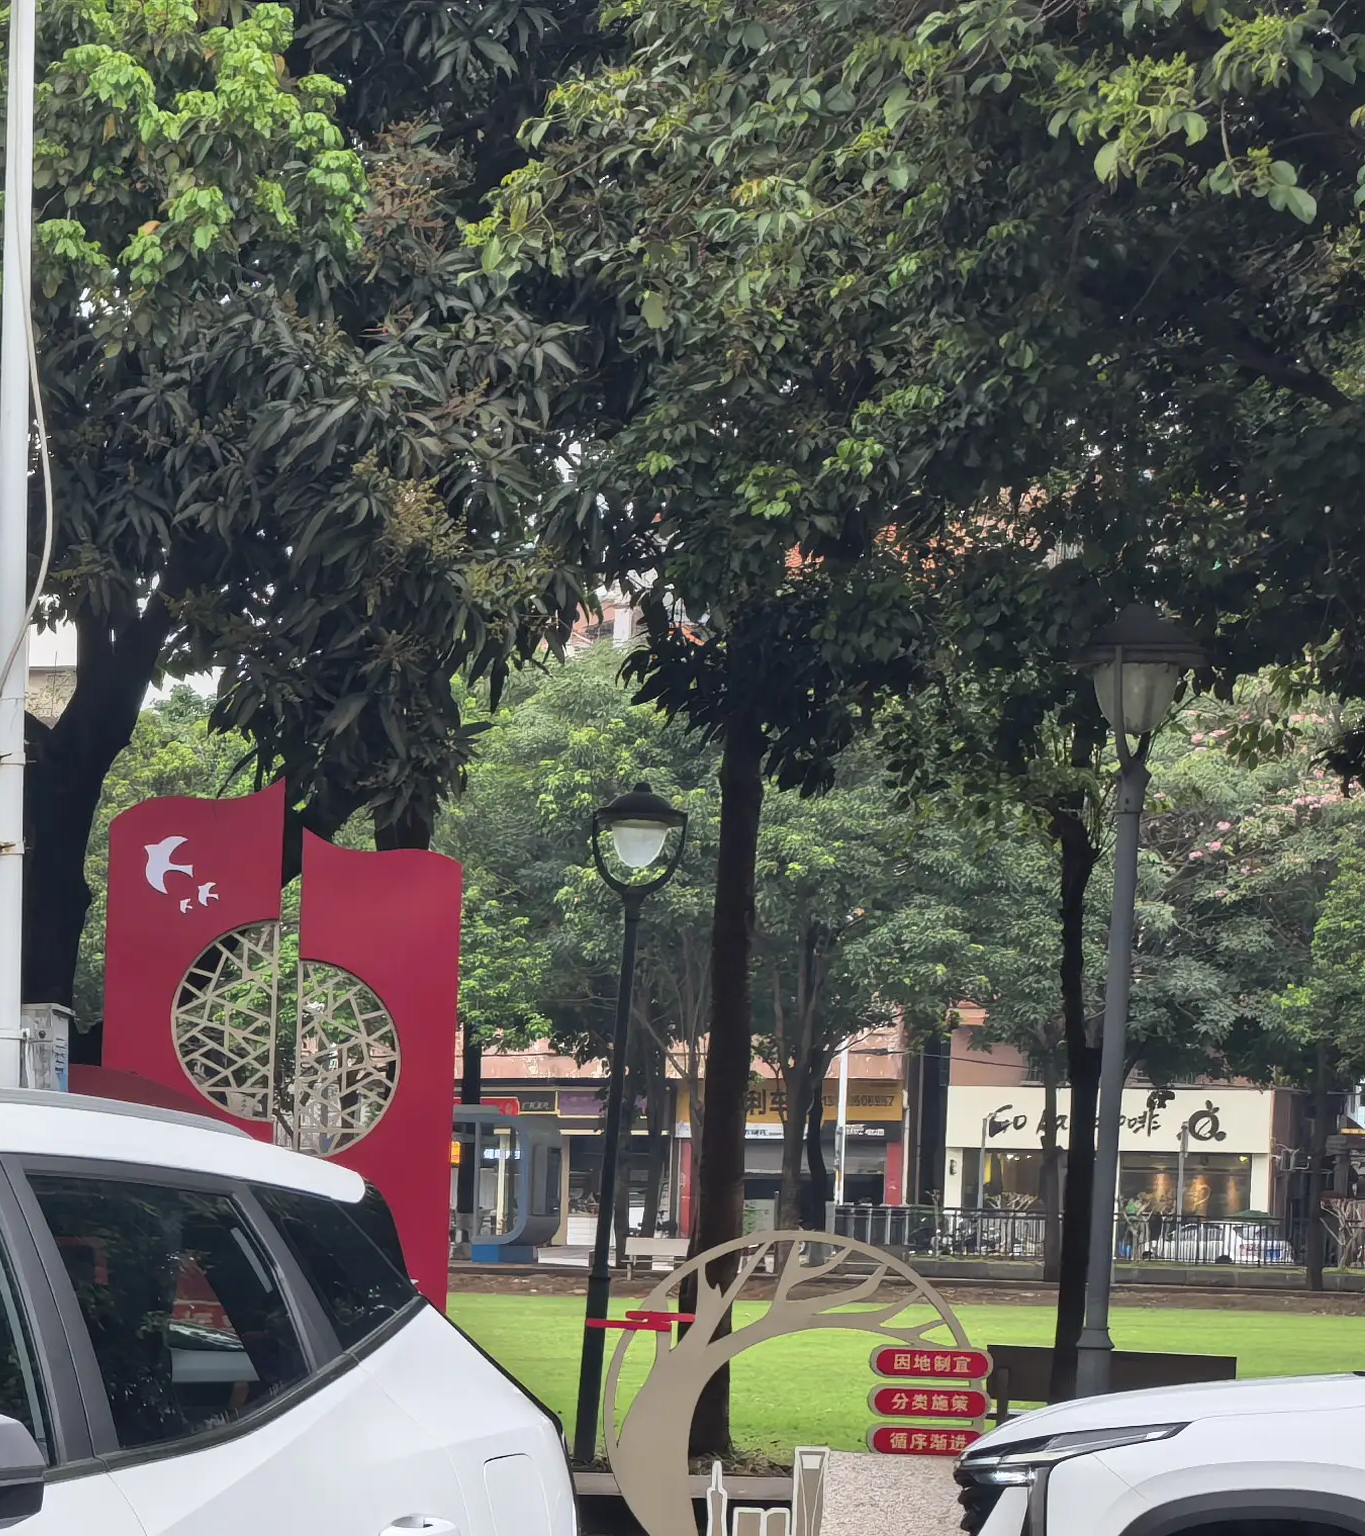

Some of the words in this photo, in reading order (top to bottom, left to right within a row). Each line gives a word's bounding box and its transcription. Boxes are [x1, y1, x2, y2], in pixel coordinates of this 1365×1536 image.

[893, 1353, 972, 1373] 因地制宜
[891, 1392, 969, 1412] 分类施策
[889, 1431, 968, 1451] 循序渐进
